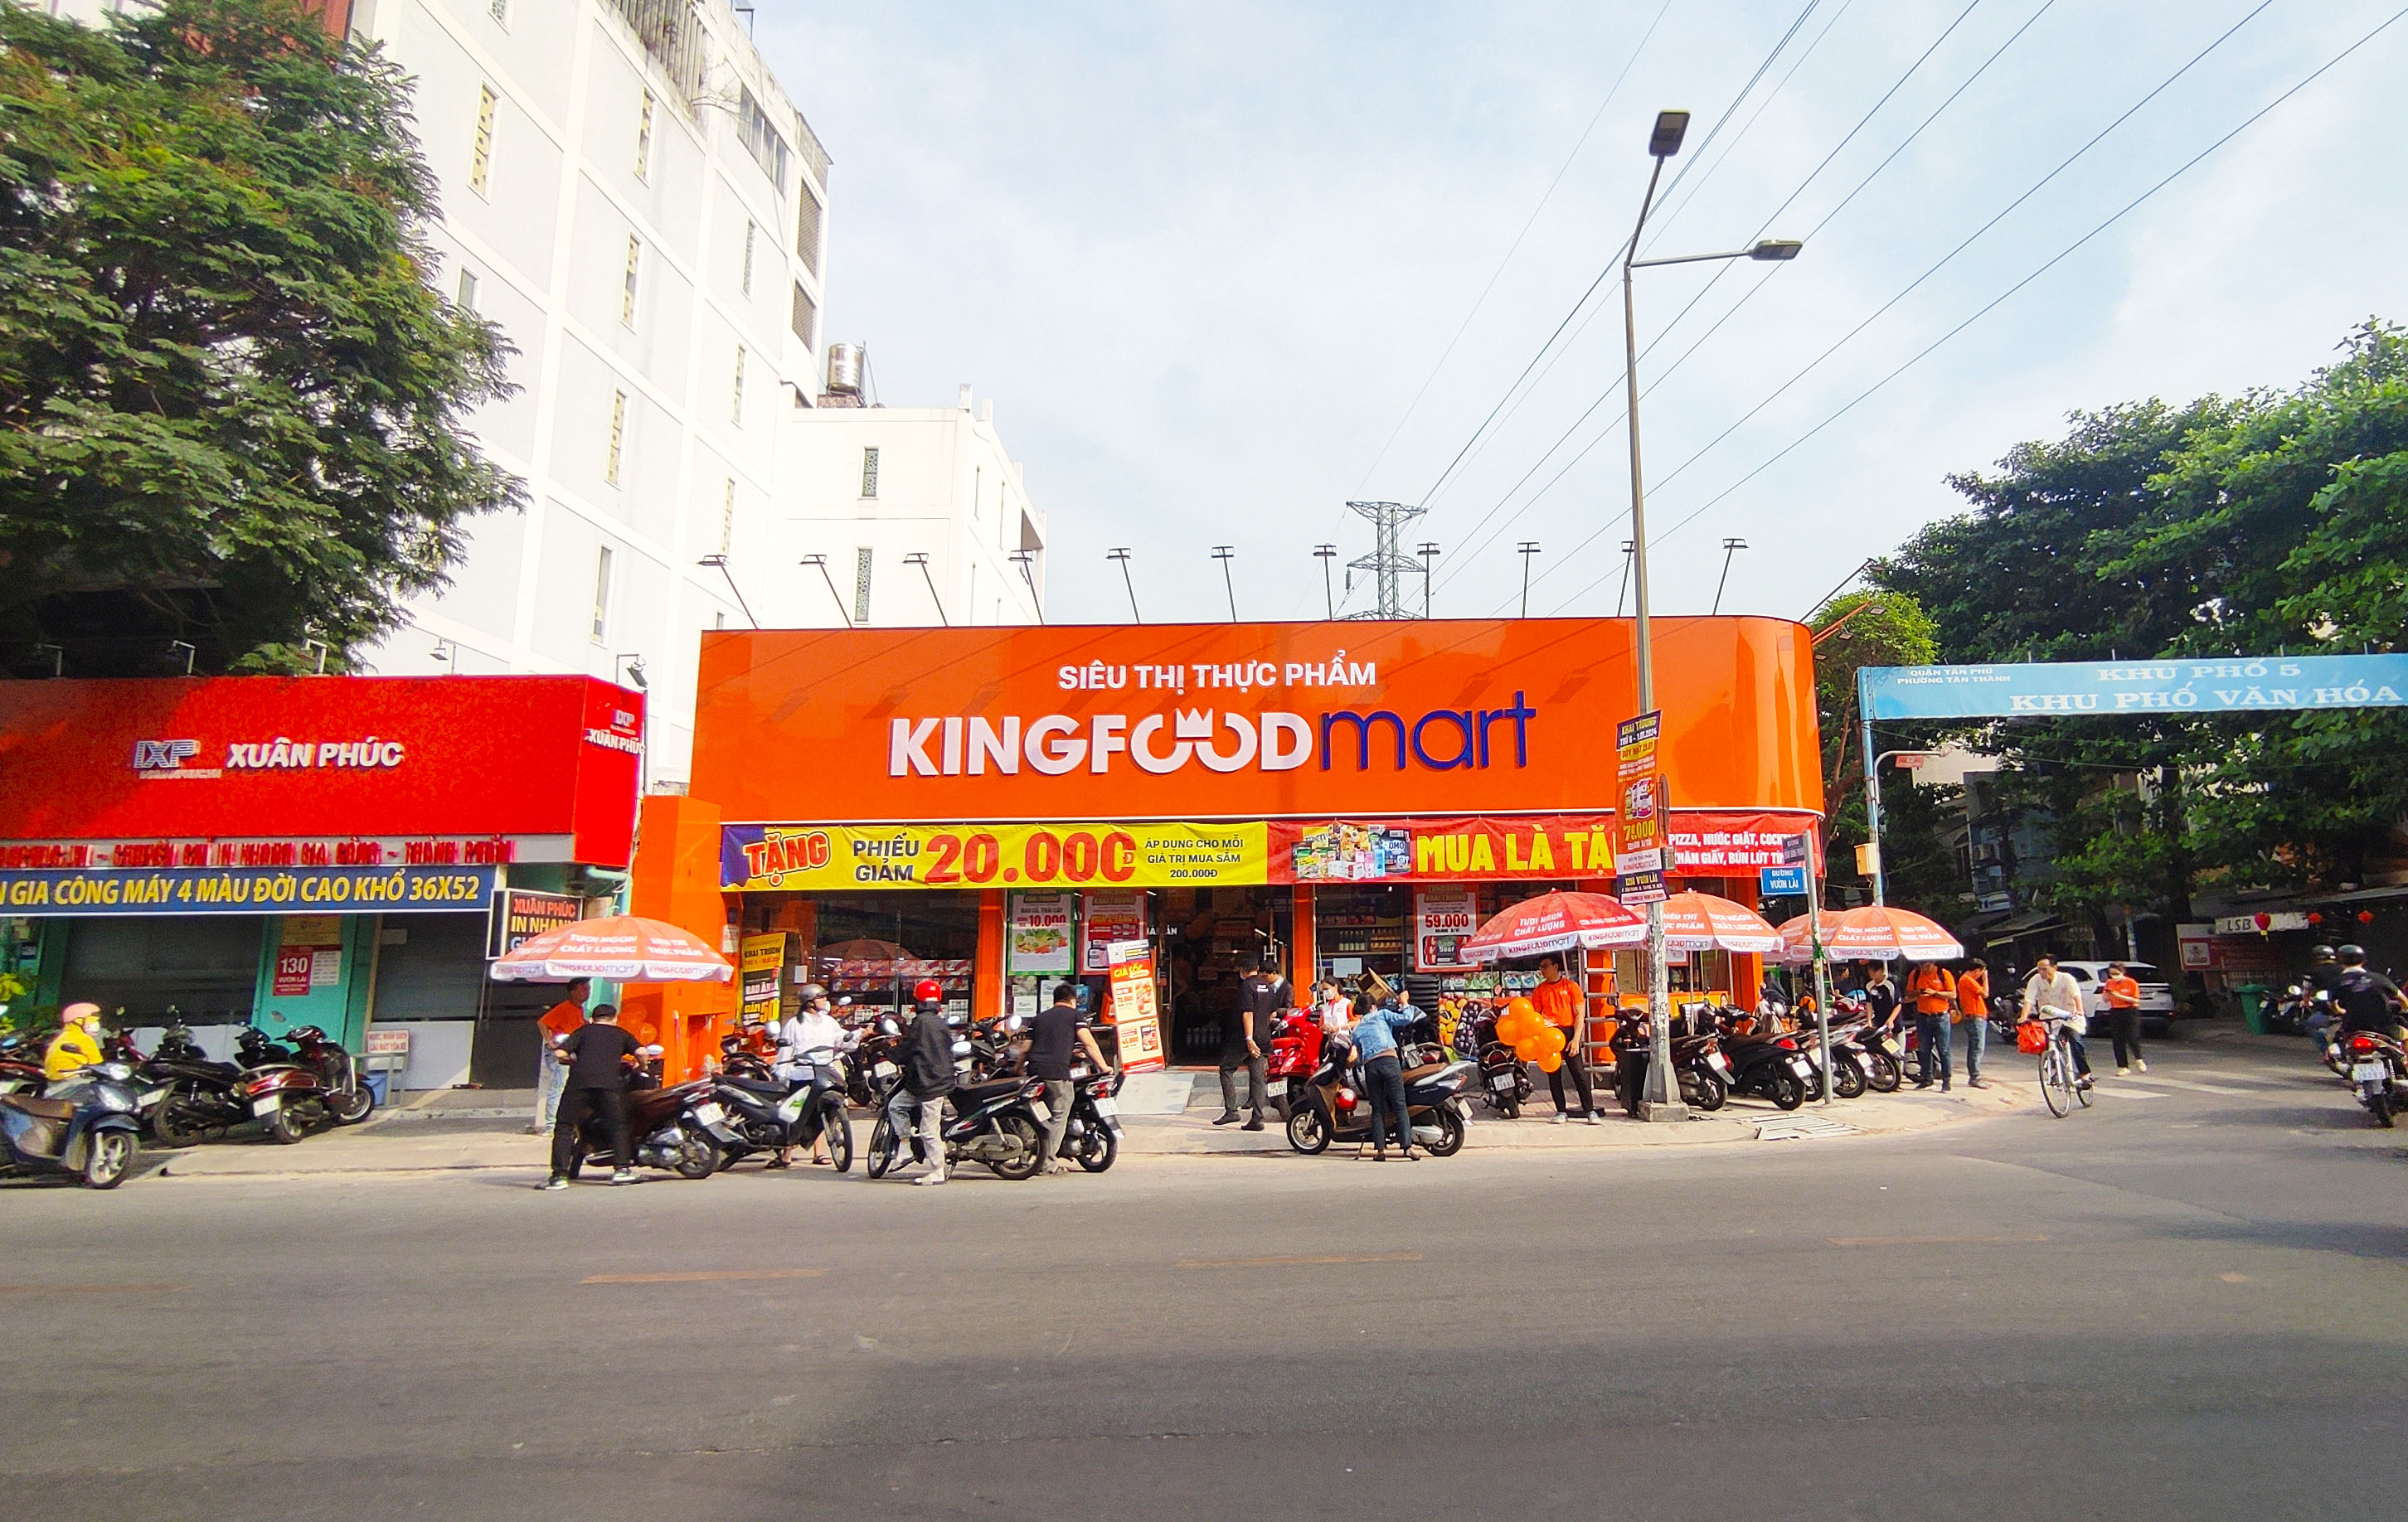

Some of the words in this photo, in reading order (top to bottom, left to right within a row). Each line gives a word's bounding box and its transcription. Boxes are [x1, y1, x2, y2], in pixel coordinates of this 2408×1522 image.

[1059, 659, 1126, 690] SIÊU
[1134, 665, 1184, 696] THỊ
[1192, 659, 1276, 693] THỰC
[1286, 648, 1376, 686] PHẨM
[1945, 667, 1968, 676] TÂN
[2097, 667, 2177, 681] KHU
[2192, 658, 2266, 677] PHỐ
[2279, 664, 2301, 676] 5
[2010, 693, 2100, 710] KHU
[2114, 681, 2197, 709] PHỐ
[2214, 686, 2299, 705] VĂN
[2313, 679, 2402, 704] HÓA
[585, 728, 619, 749] XUÂN
[226, 736, 313, 768] XUÂN
[318, 735, 405, 767] PHÚC
[853, 831, 920, 857] PHIẾU
[1145, 836, 1160, 849] ÁP
[1163, 838, 1193, 851] DỤNG
[1196, 838, 1220, 849] CHO
[1221, 833, 1244, 848] MỖI
[1387, 839, 1405, 850] OMO
[1416, 833, 1496, 872] MUA
[1505, 823, 1556, 870] LÀ
[1564, 824, 1616, 875] TẶ
[1668, 833, 1702, 846] PIZZA,
[1703, 830, 1731, 846] NƯỚC
[1732, 831, 1758, 849] GIẶT,
[745, 831, 829, 885] TẶNG
[1148, 852, 1168, 865] GIÁ
[1168, 854, 1187, 866] TRỊ
[1189, 853, 1214, 864] MUA
[1728, 851, 1750, 864] BÚN
[856, 857, 914, 881] GIẢM
[10, 880, 49, 905] GIA
[54, 875, 120, 905] CÔNG
[123, 873, 175, 904] MÁY
[177, 880, 192, 903] 4
[196, 873, 250, 903] MÀU
[253, 872, 297, 903] ĐỜI
[301, 876, 350, 902] CAO
[354, 868, 406, 902] KHỔ
[409, 875, 480, 901] 36X52
[513, 897, 546, 915] XUÂN
[547, 900, 575, 917] PHÚC
[511, 915, 527, 933] IN
[1425, 914, 1469, 928] 59.000
[1514, 923, 1536, 936] CHẤT
[1537, 920, 1565, 933] LƯỢNG
[2227, 918, 2251, 932] LSB
[281, 957, 308, 974] 130
